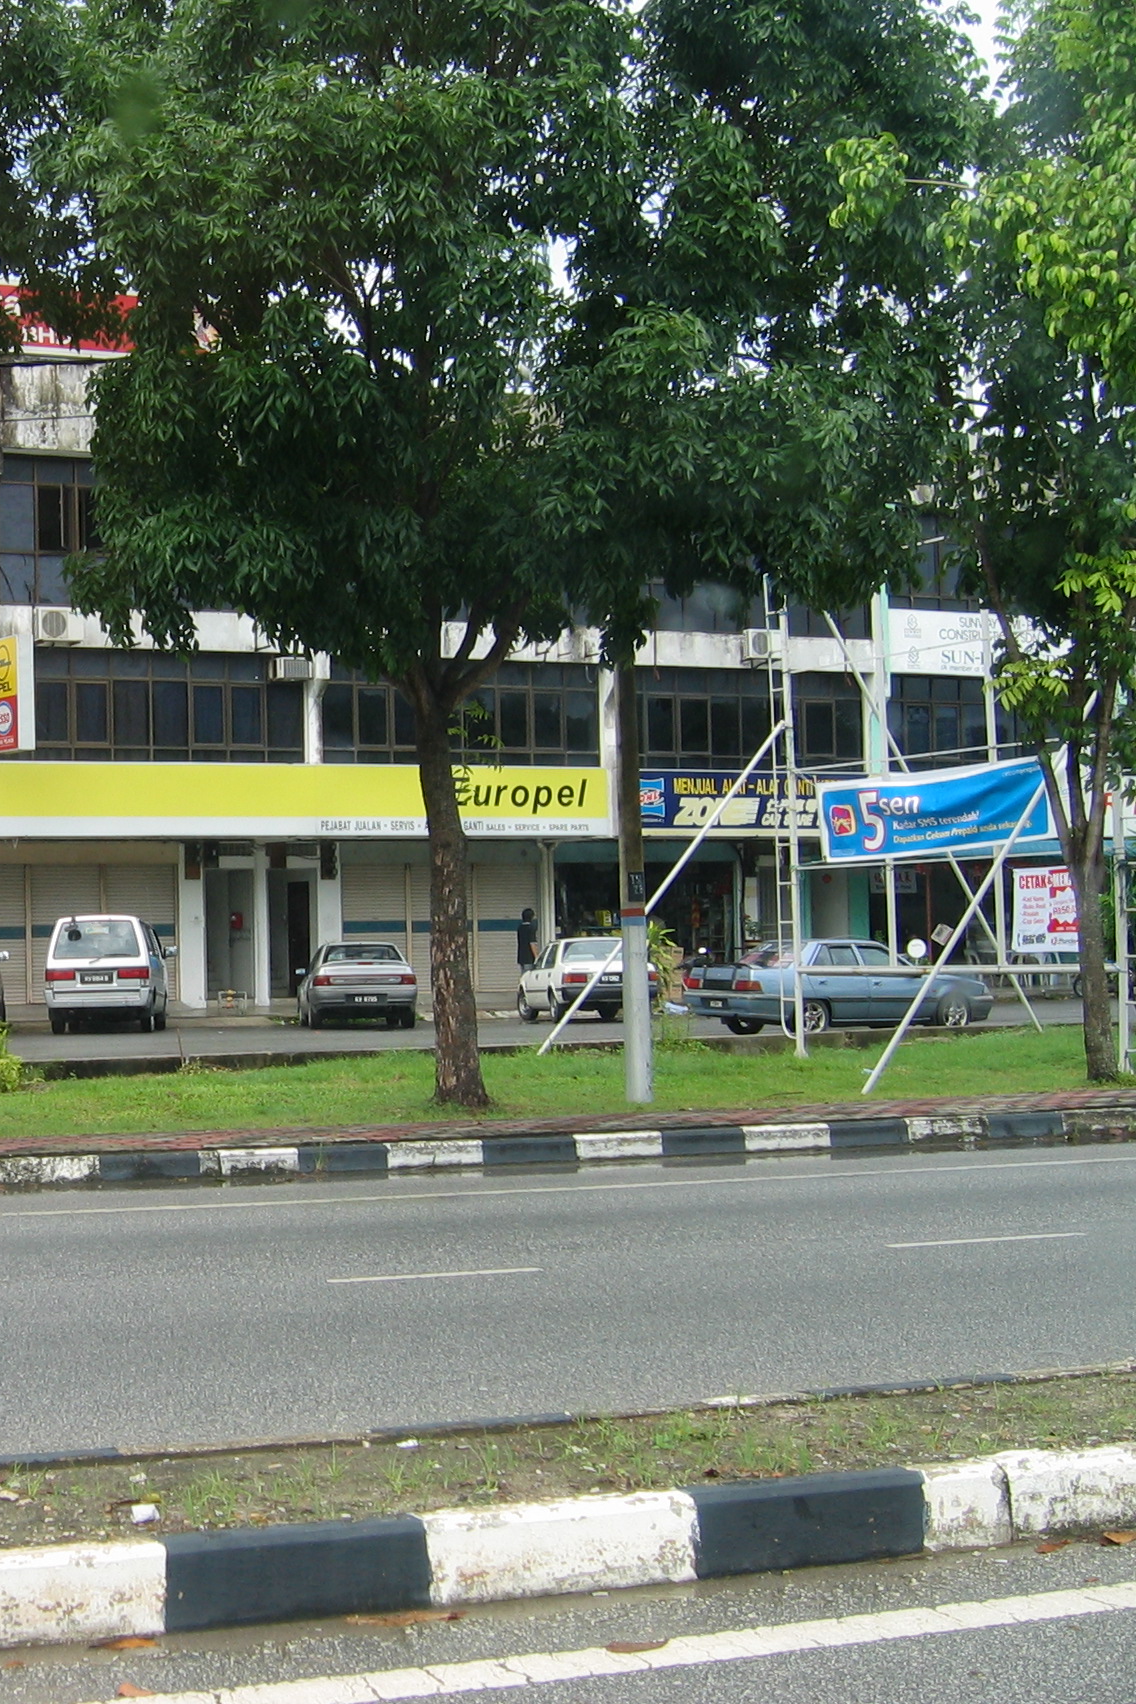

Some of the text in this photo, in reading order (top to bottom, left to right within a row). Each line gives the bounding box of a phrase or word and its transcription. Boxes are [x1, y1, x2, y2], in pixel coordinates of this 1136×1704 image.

[673, 778, 717, 795] MENJUAL
[453, 778, 588, 815] Europel
[320, 820, 351, 831] PEJABAT
[354, 821, 381, 831] JUALAN
[390, 821, 415, 831] SERVIS
[514, 823, 540, 831] SERVICE
[858, 790, 921, 852] 5 sen
[917, 818, 938, 829] SMS
[1019, 875, 1046, 889] CETAK
